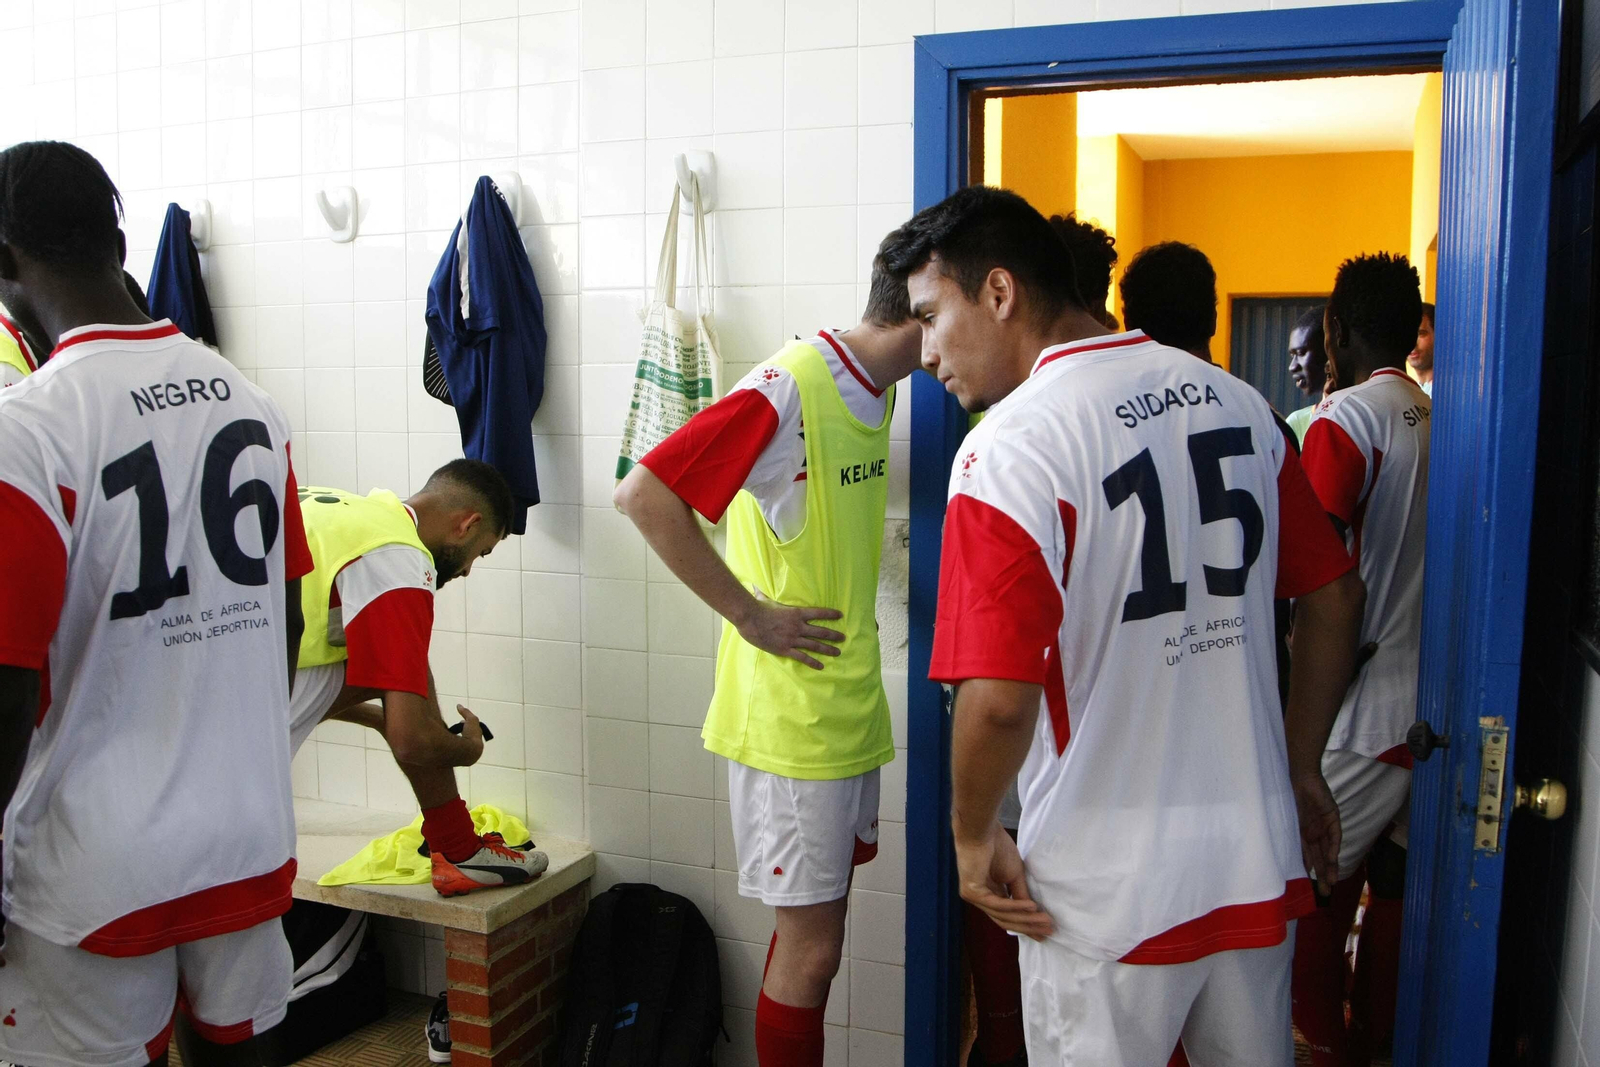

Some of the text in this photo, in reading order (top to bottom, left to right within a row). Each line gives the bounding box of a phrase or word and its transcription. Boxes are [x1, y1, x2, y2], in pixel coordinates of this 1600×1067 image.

[130, 377, 231, 416] NEGRO
[1115, 382, 1223, 429] SUDACA
[840, 458, 885, 487] KELME
[101, 418, 280, 621] 16
[1102, 426, 1265, 624] 15
[160, 600, 262, 629] ALMA DE ÁFRICA
[163, 618, 269, 647] UNIÓN DEPORTIVA
[1164, 635, 1183, 647] AL
